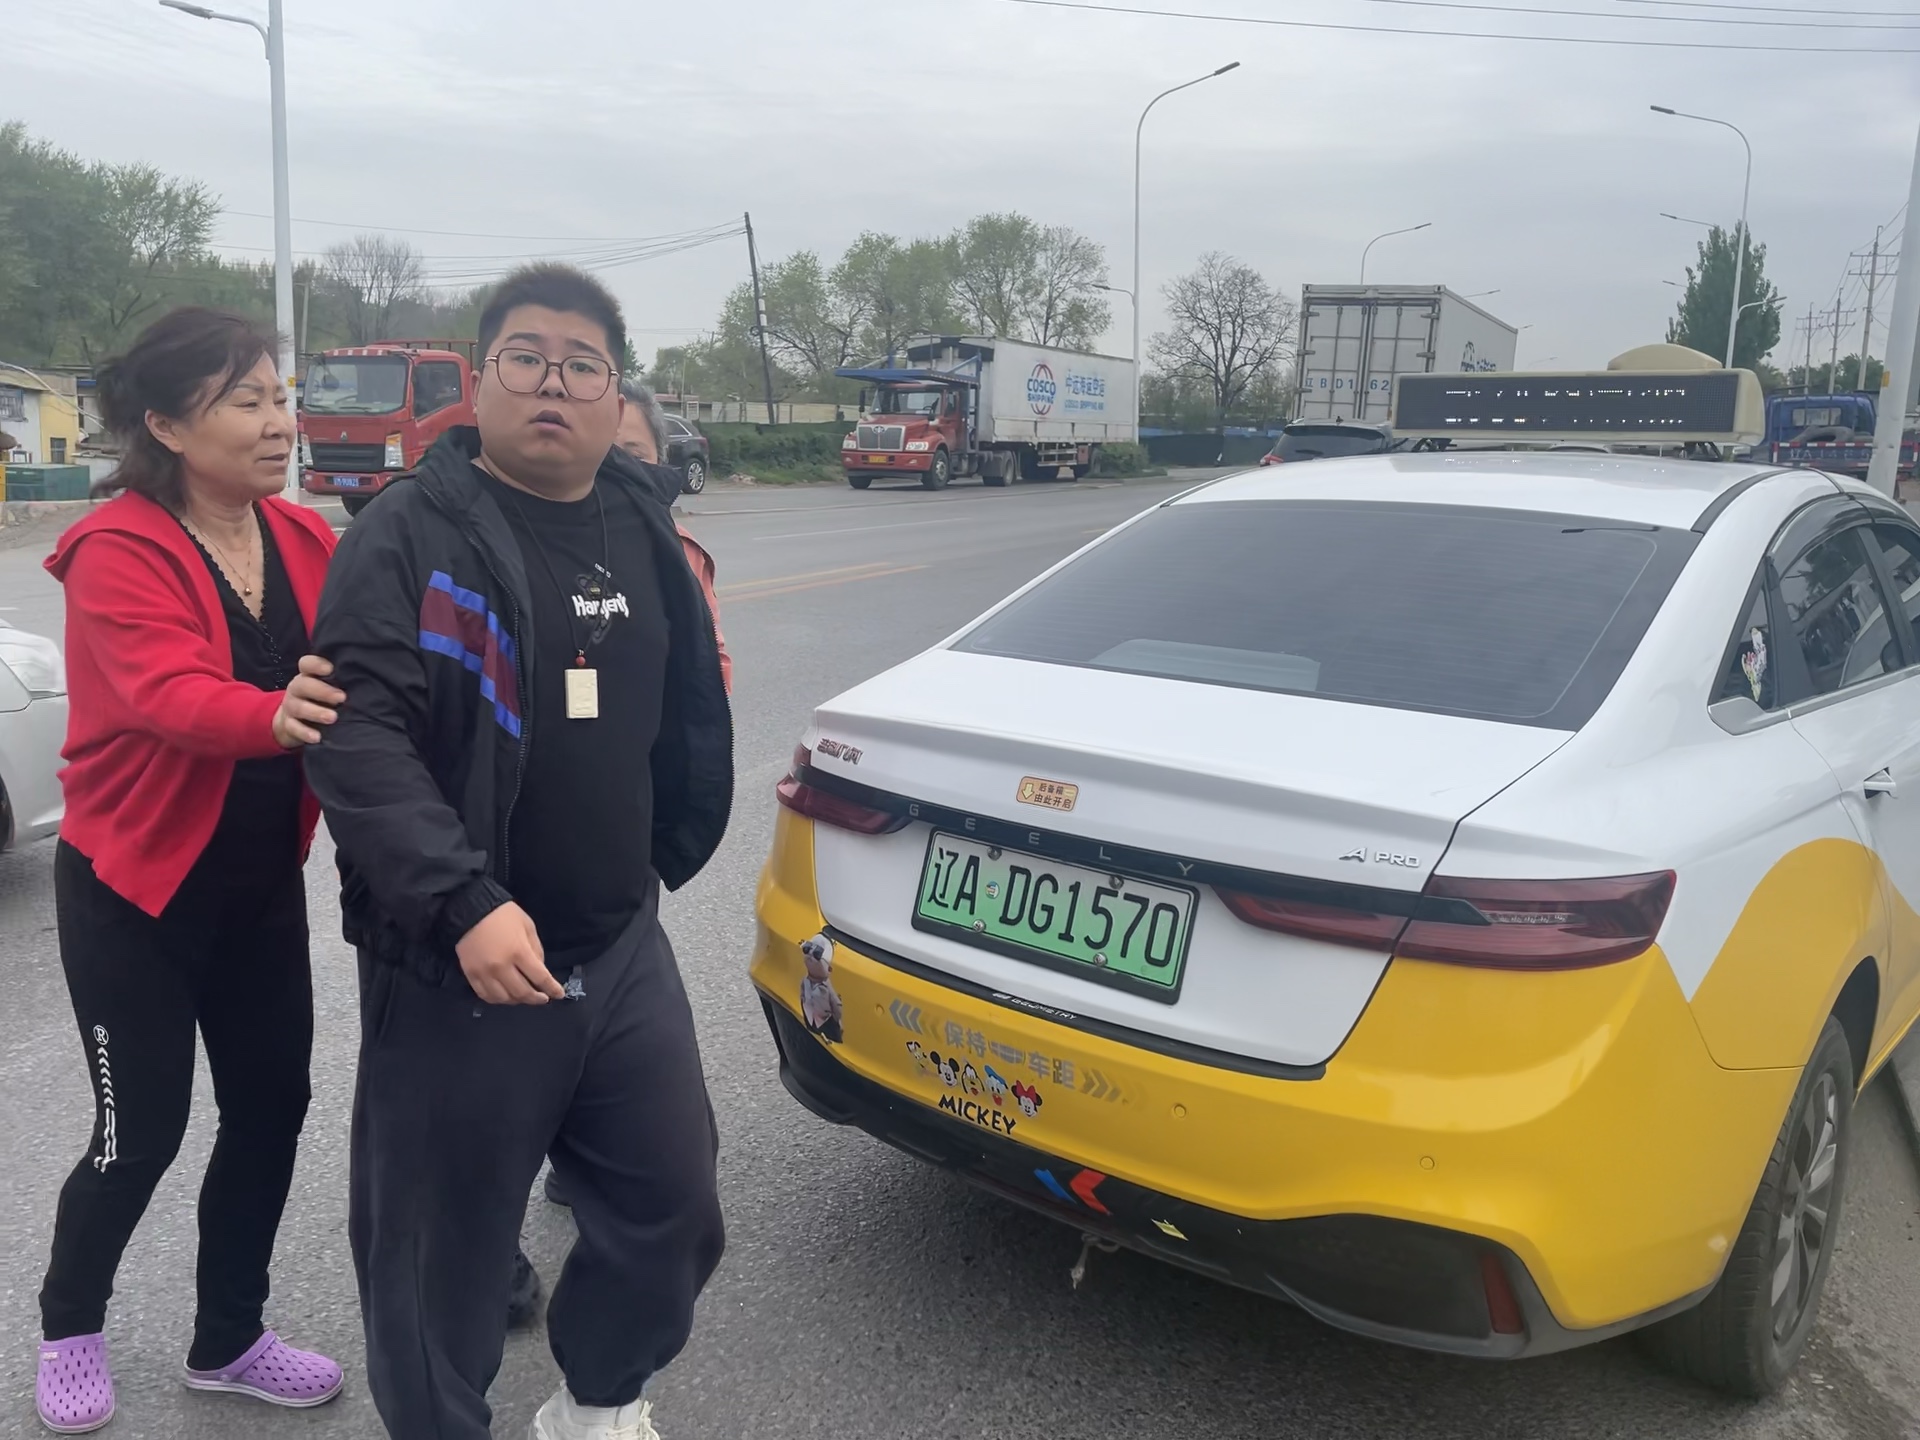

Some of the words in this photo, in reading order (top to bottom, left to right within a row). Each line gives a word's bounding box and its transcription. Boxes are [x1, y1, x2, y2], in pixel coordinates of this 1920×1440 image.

[1027, 378, 1056, 396] COSCO
[1027, 393, 1054, 404] SHIPPING
[1038, 782, 1064, 795] 后备箱
[1033, 793, 1072, 809] 由此开启
[908, 804, 1194, 876] GEELY
[1338, 847, 1367, 863] A
[1375, 851, 1420, 869] PRO
[1011, 998, 1077, 1020] GEOMETRY
[945, 1018, 988, 1058] 保持
[1028, 1050, 1077, 1090] 车距
[938, 1093, 1017, 1136] MICKEY
